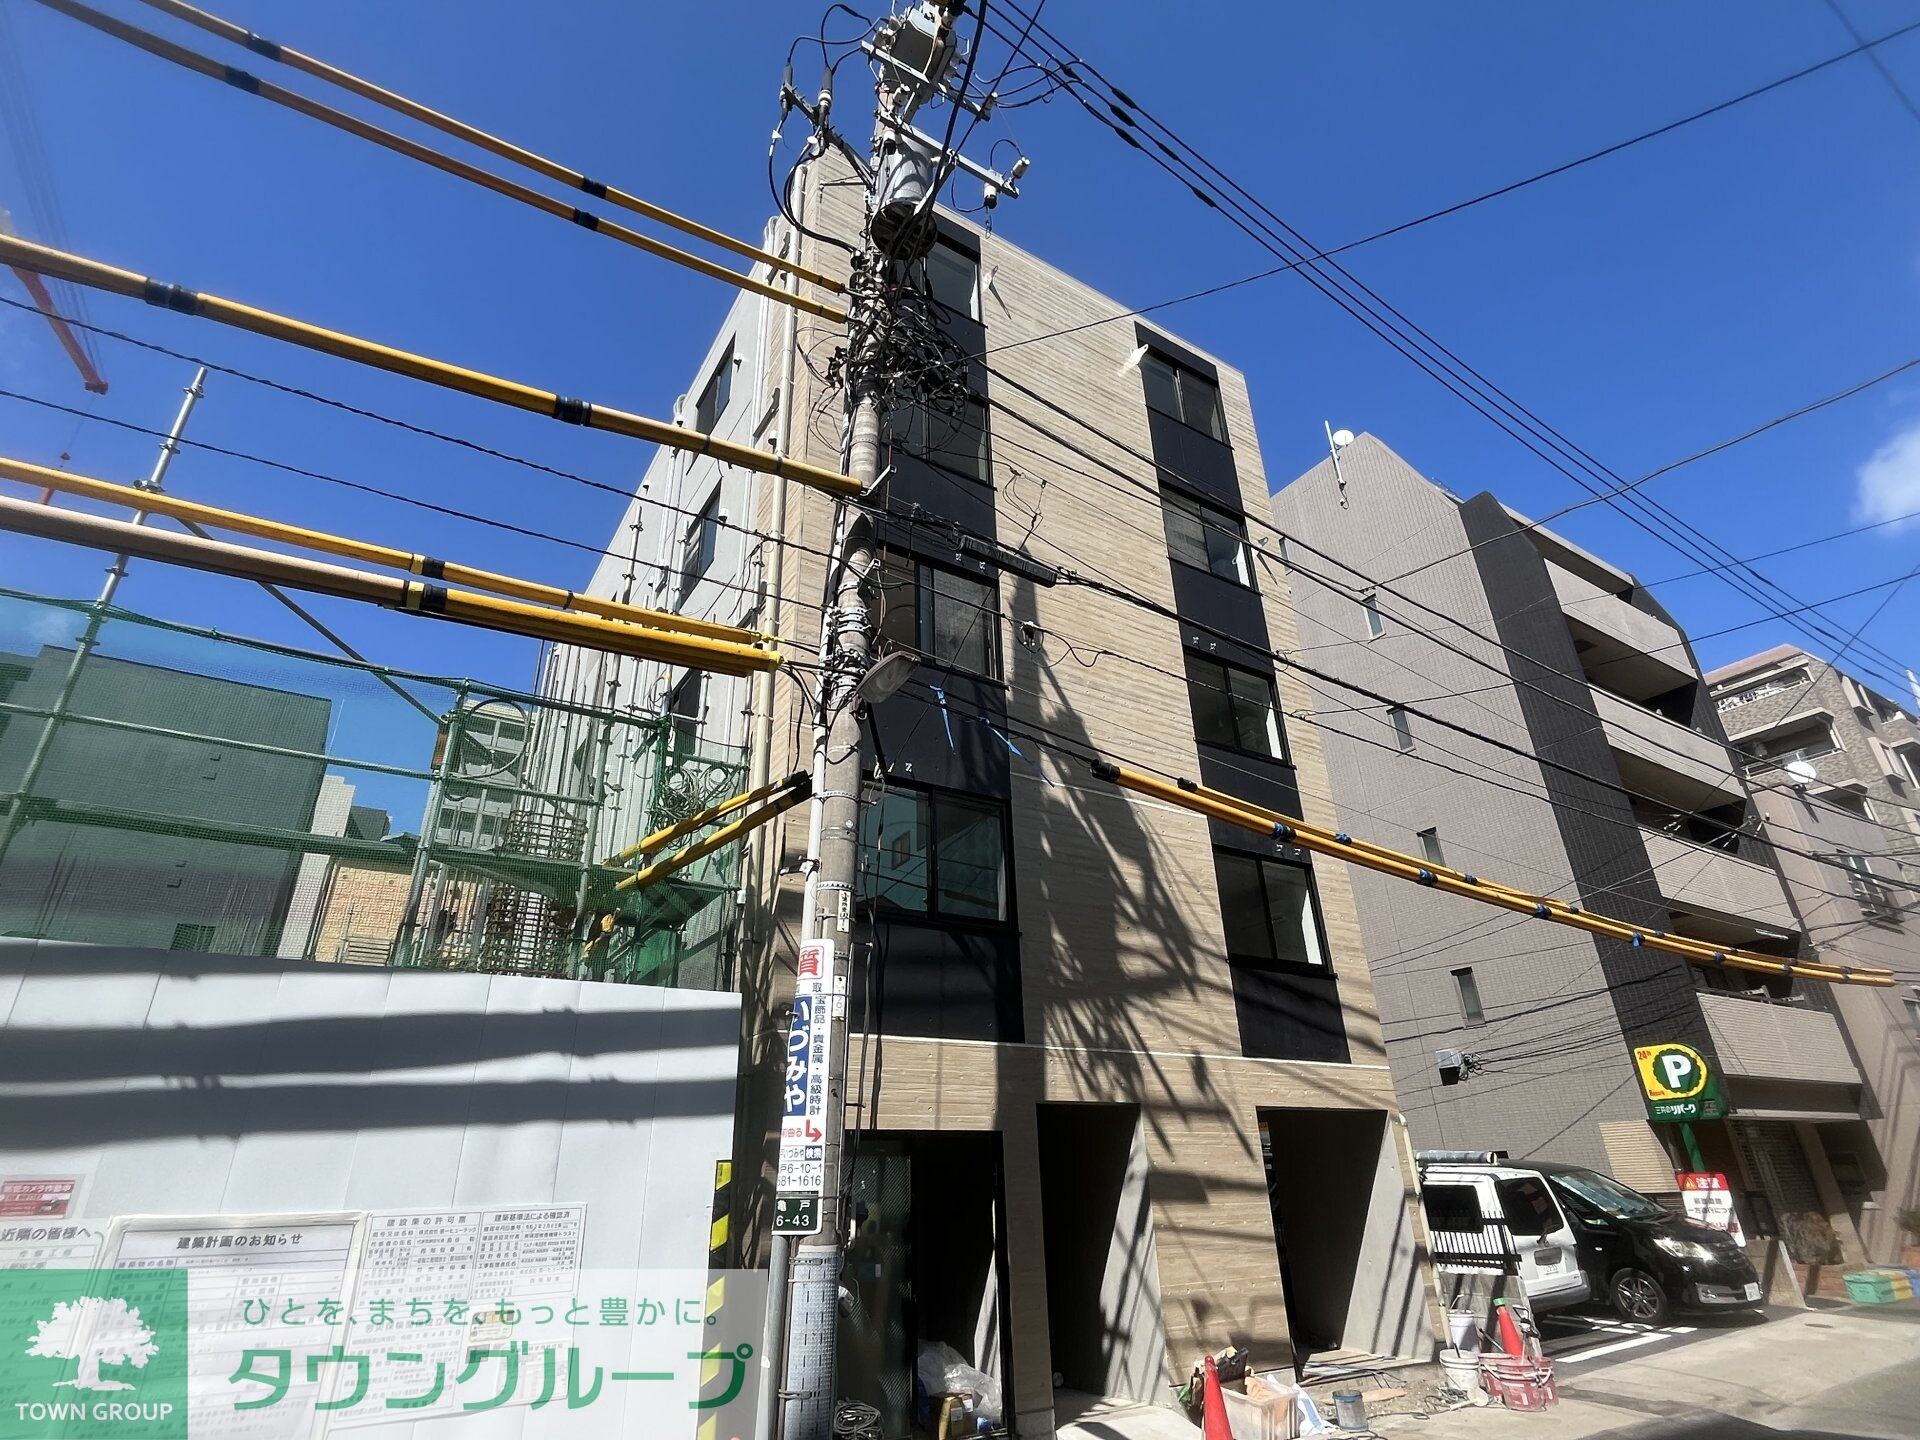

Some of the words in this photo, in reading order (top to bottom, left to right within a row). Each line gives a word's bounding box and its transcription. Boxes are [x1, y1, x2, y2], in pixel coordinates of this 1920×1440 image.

[1661, 1054, 1692, 1088] P
[776, 1215, 810, 1227] 6-43
[1, 1226, 92, 1241] 近隣の皆様へ
[176, 1233, 304, 1250] 建築計画のお知らせ
